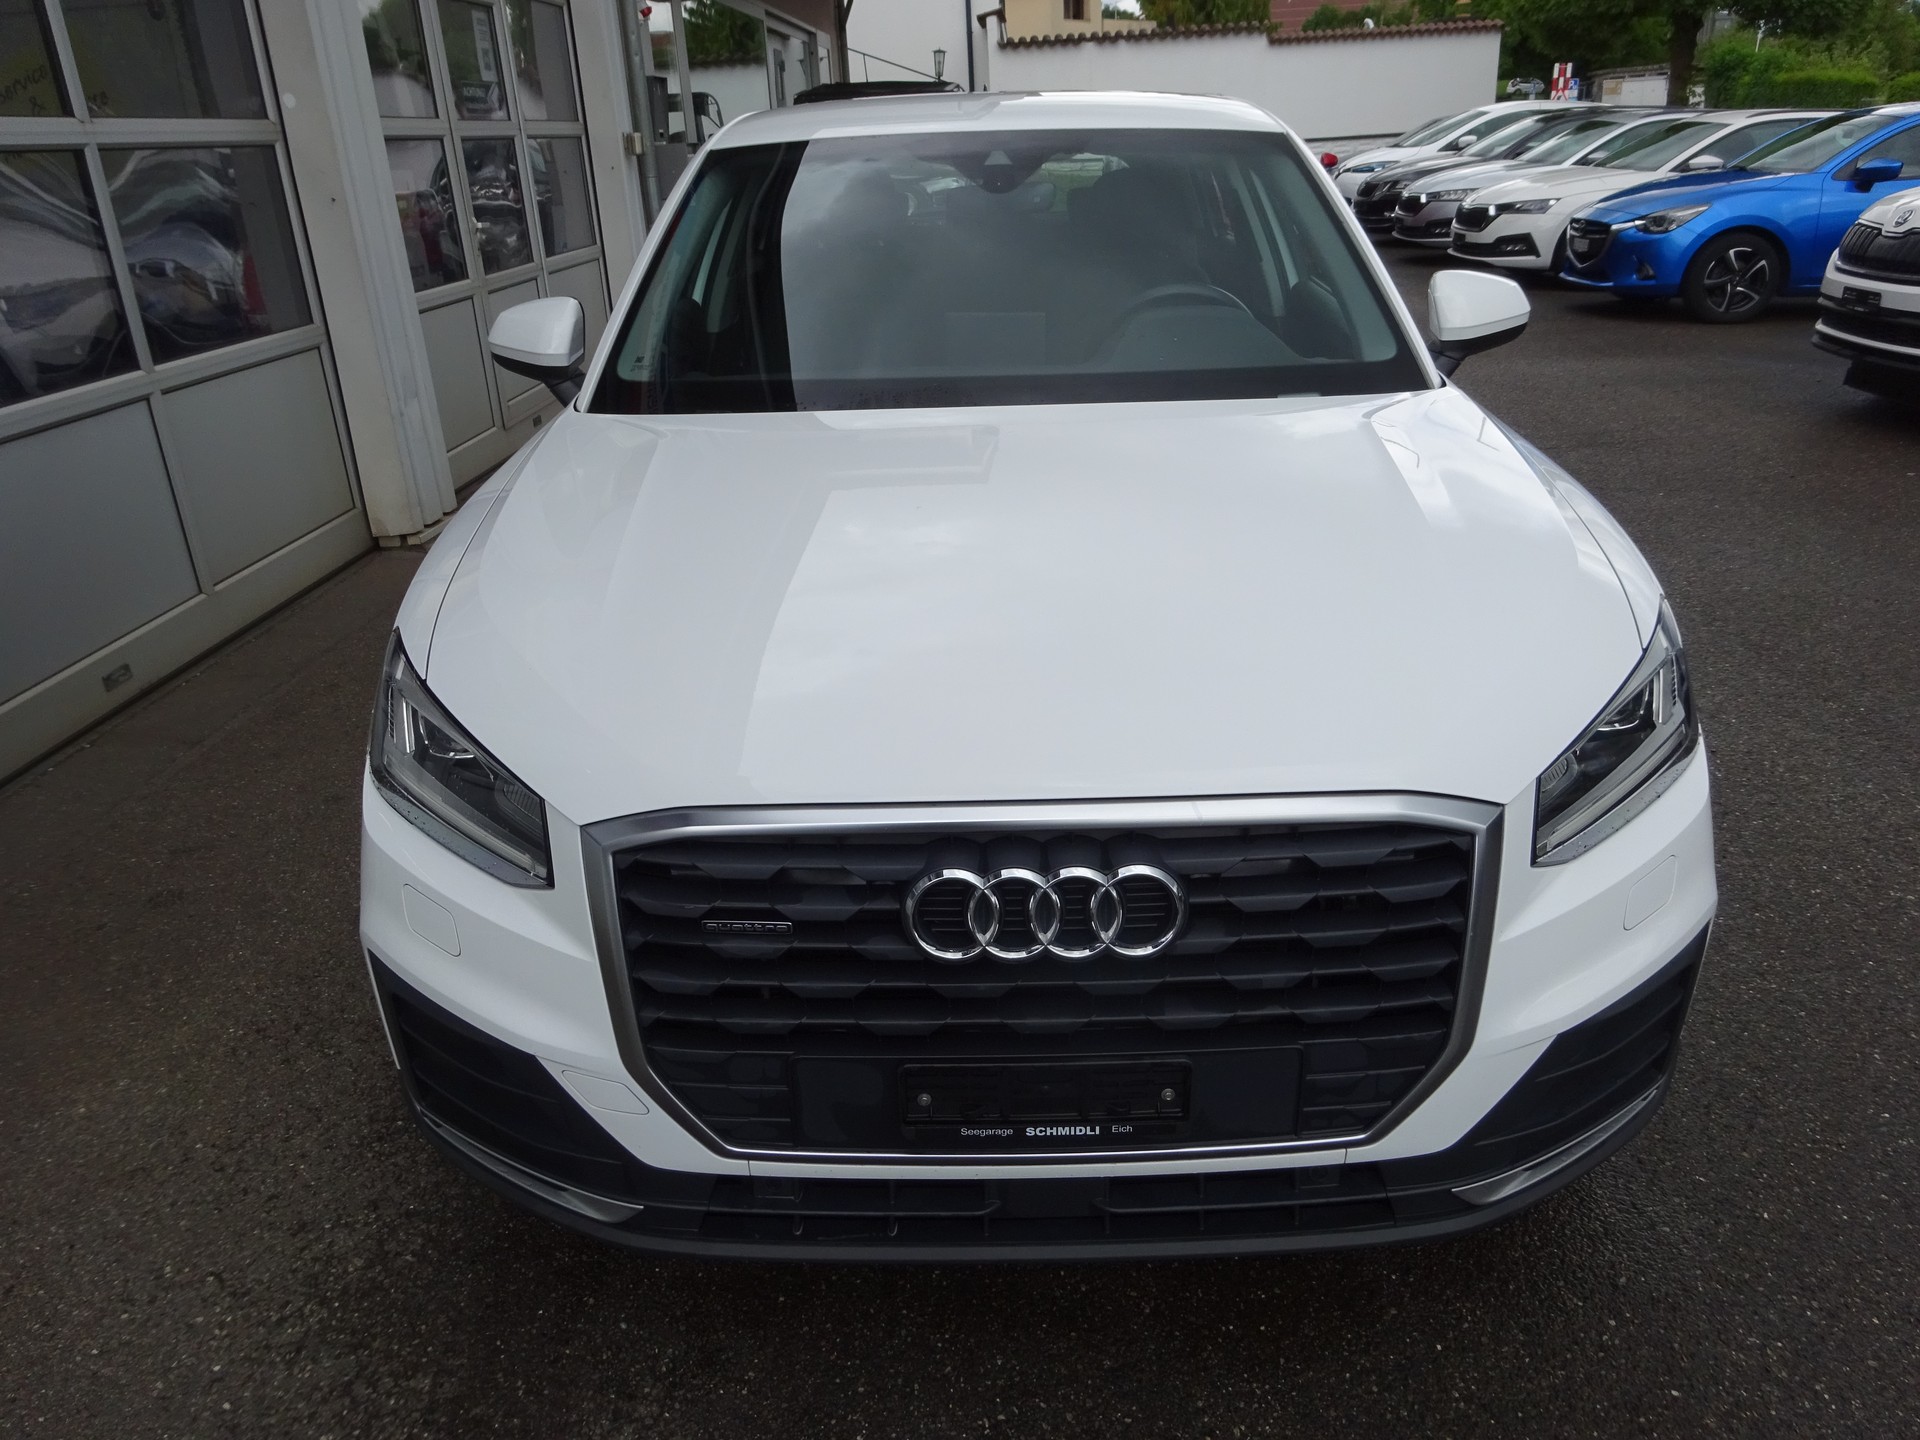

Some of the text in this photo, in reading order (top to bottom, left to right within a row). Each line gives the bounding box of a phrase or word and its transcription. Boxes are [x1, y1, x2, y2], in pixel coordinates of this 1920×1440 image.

[704, 922, 789, 934] quattro
[960, 1124, 1133, 1137] Seegarage SCHMIDLI Eich
